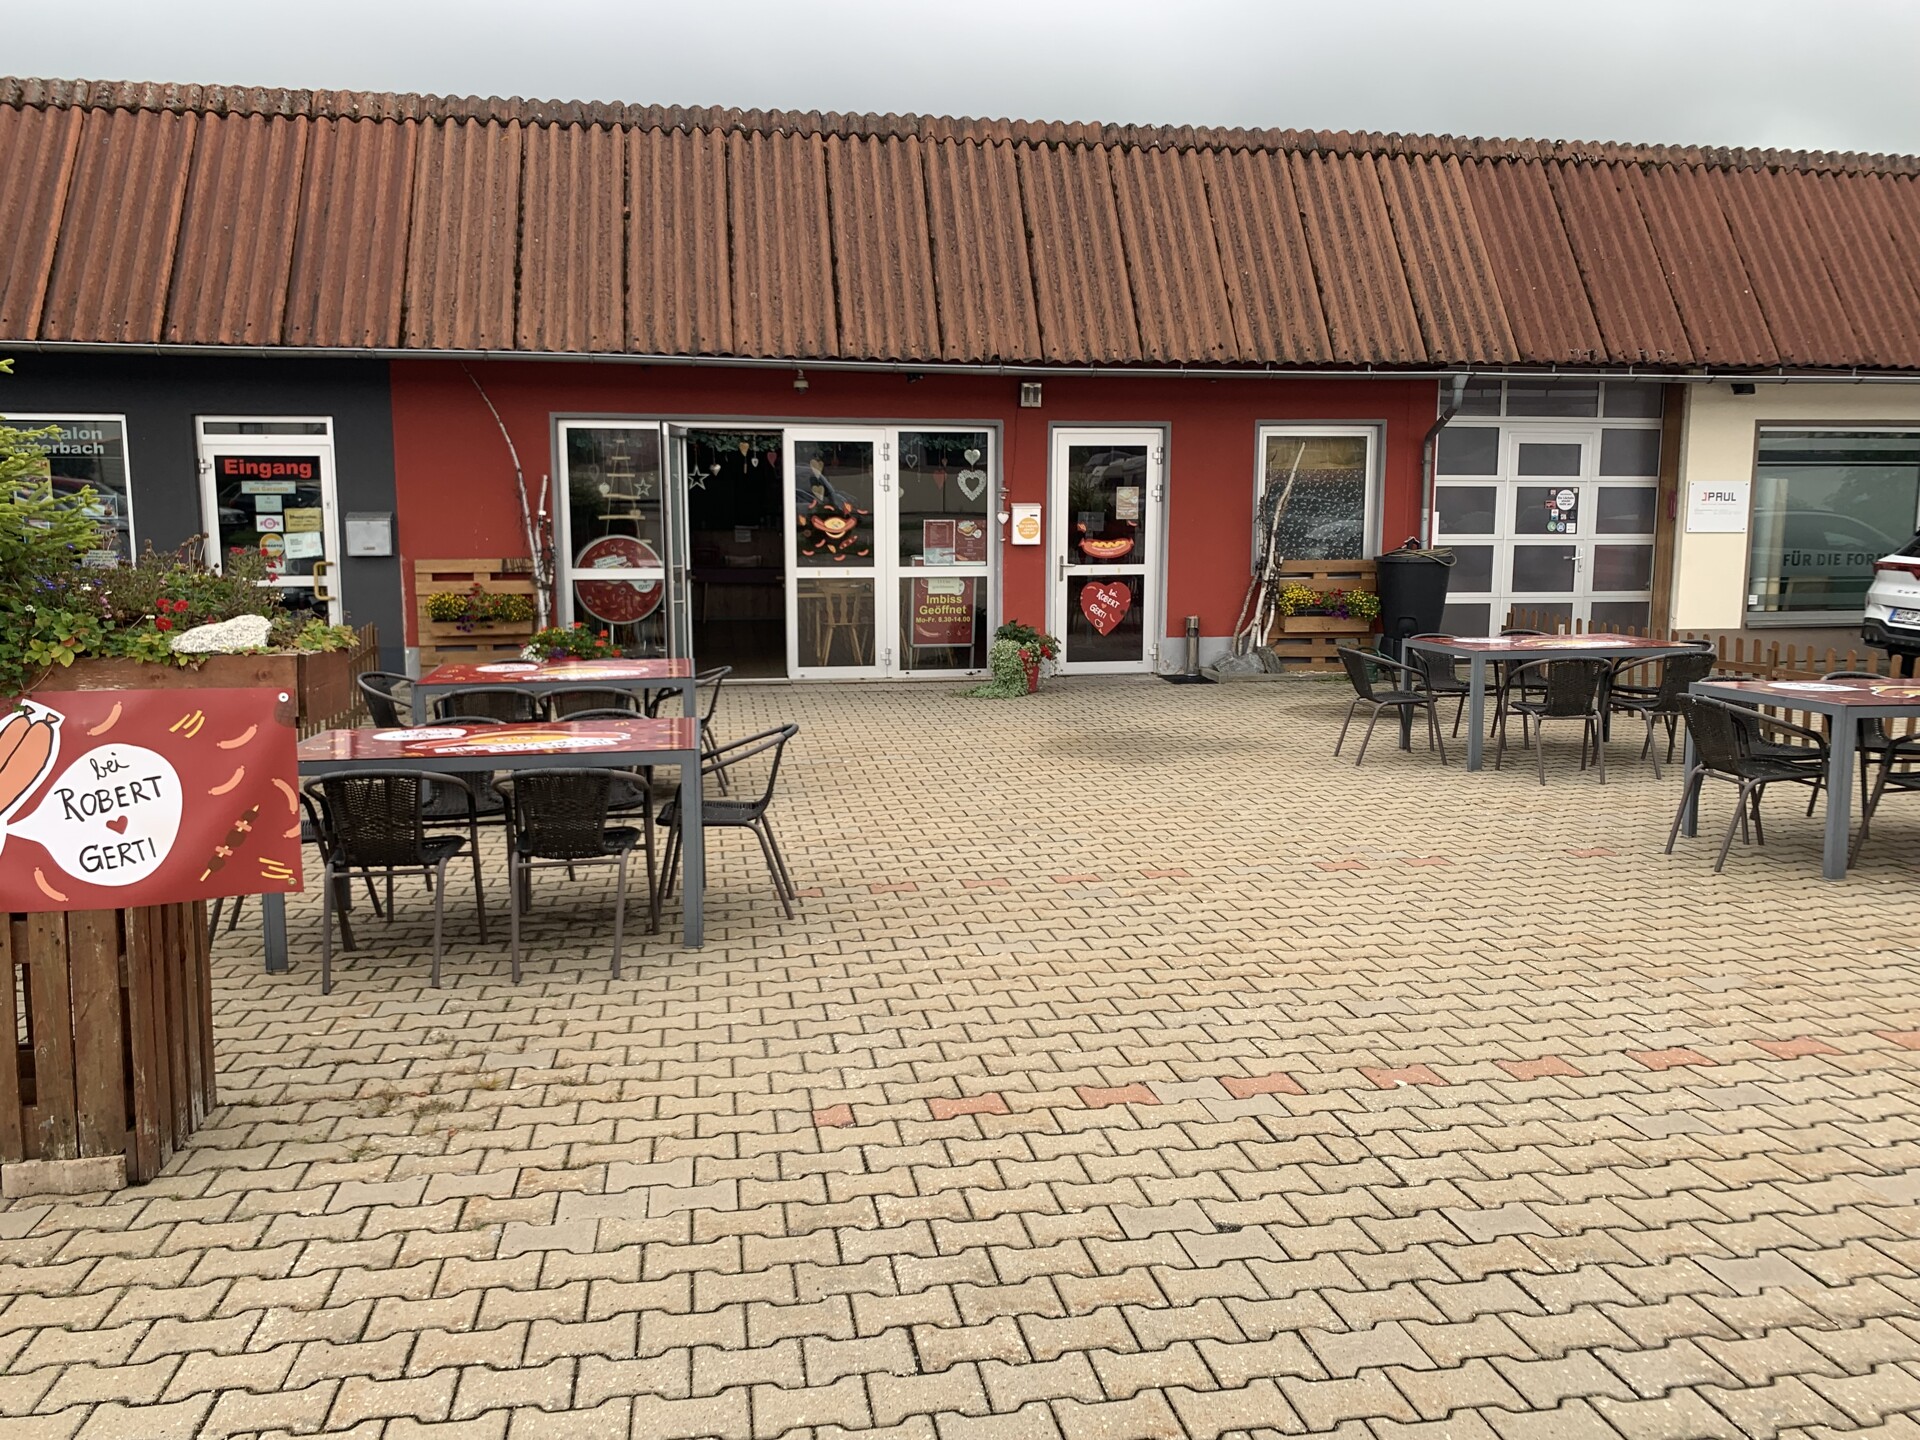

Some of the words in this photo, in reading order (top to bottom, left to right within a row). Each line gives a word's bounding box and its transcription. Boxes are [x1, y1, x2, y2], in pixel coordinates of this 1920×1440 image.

[3, 426, 103, 440] osalon
[224, 459, 312, 478] Eingang
[1783, 551, 1811, 567] FÜR
[1816, 553, 1842, 566] DIE
[926, 594, 963, 605] Imbiss
[1096, 588, 1121, 609] ROBERT
[919, 604, 967, 616] Geöffnet
[1089, 603, 1107, 619] GERTI
[915, 616, 937, 624] Mo-Fr.
[89, 752, 130, 780] bei
[54, 775, 163, 822] ROBERT
[79, 837, 157, 873] GERTI
